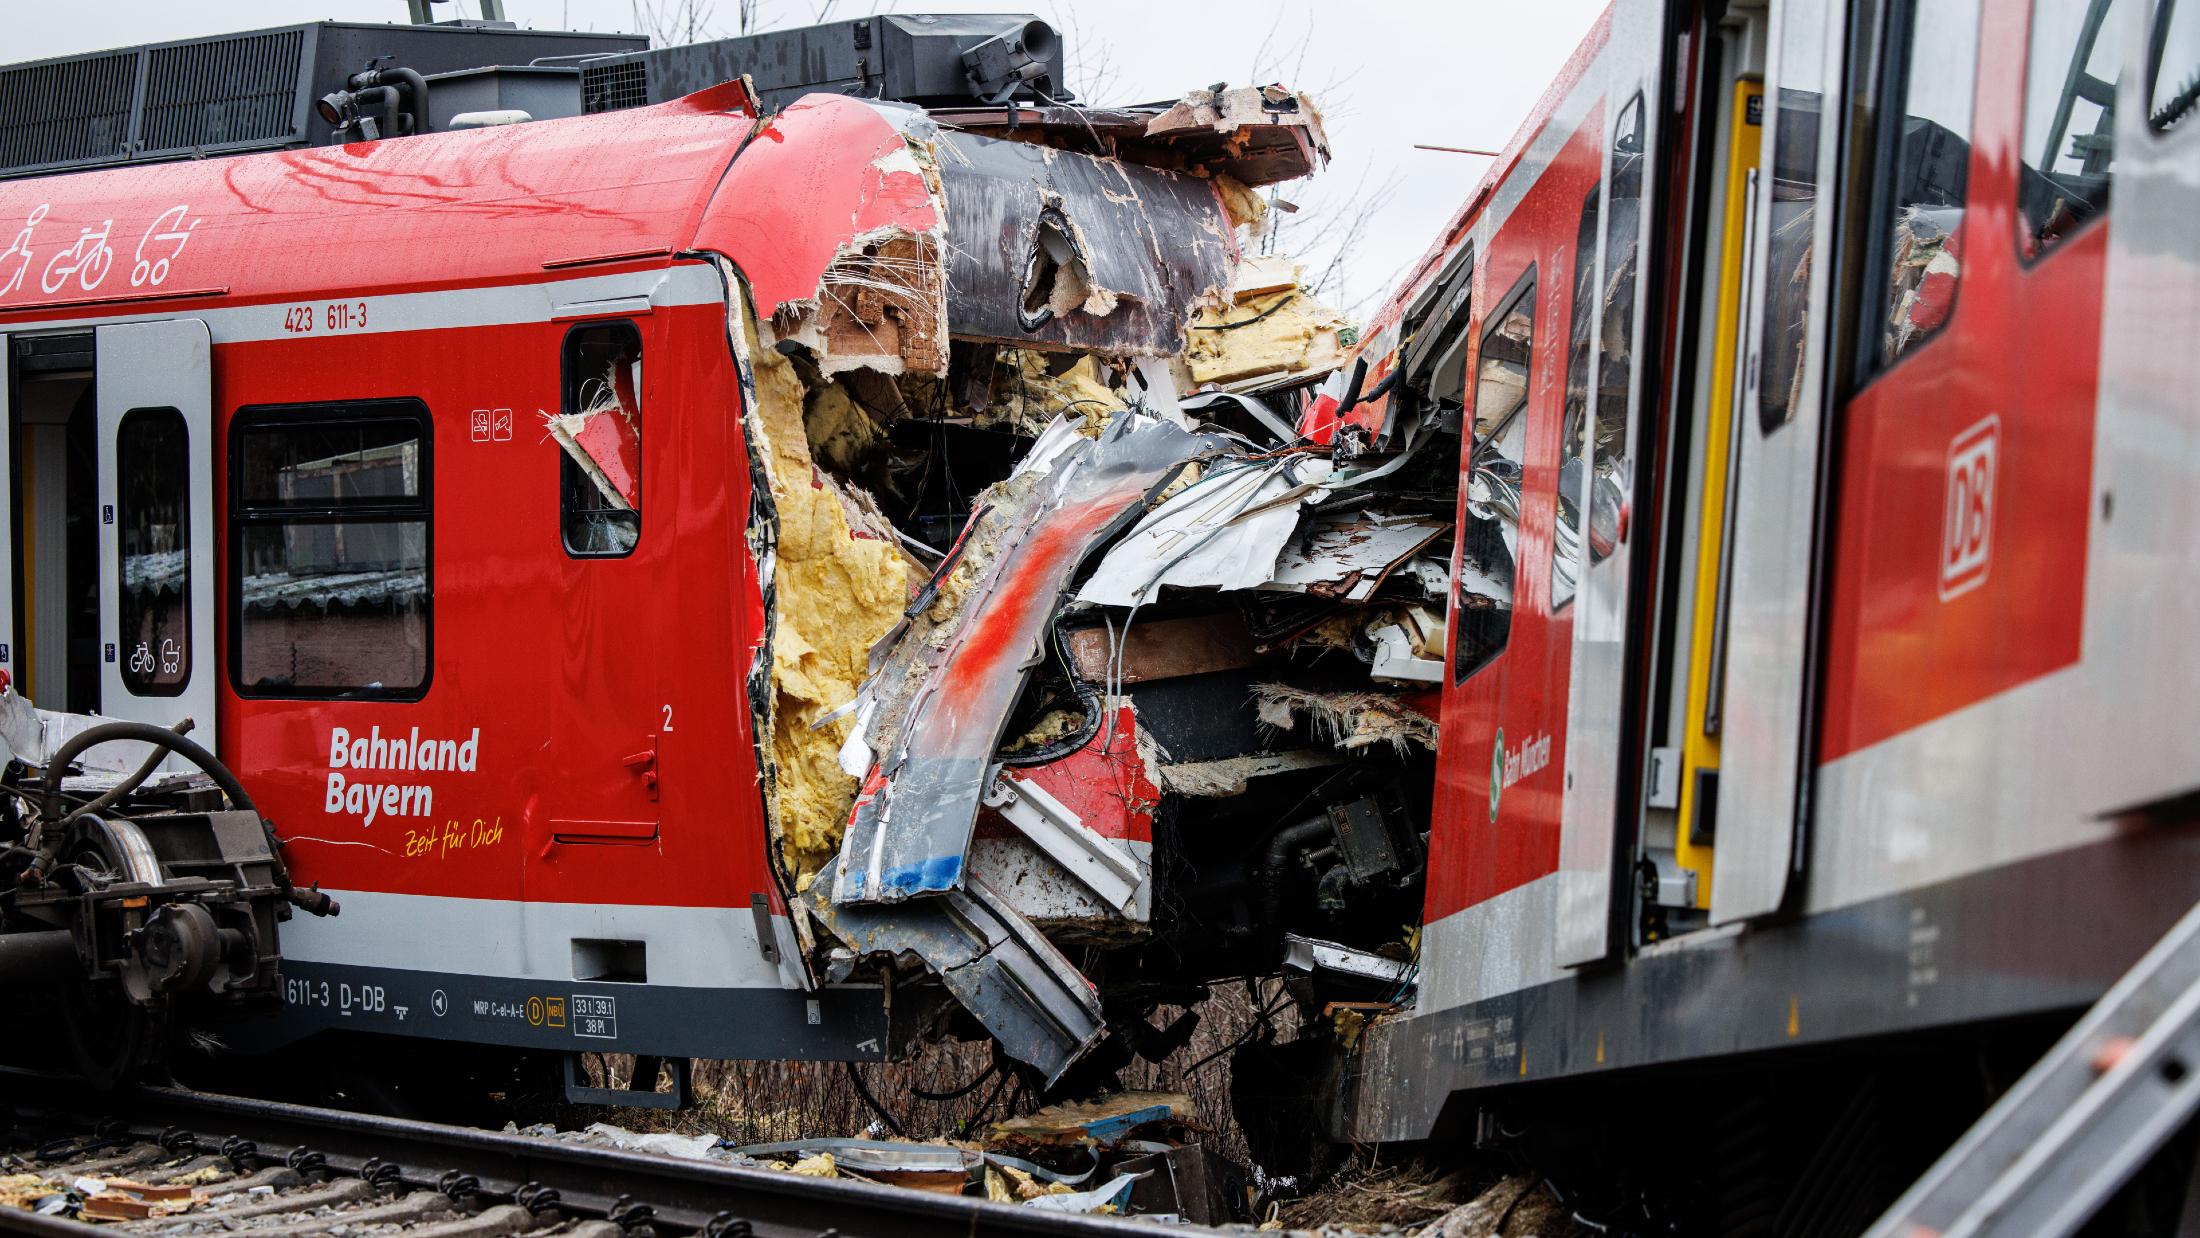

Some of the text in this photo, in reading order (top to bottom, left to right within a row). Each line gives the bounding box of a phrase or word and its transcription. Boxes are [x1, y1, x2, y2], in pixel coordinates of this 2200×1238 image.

[283, 302, 367, 332] 423 611-3
[1945, 438, 1993, 577] DB
[662, 703, 674, 732] 2
[329, 725, 480, 772] Bahnland
[325, 772, 433, 828] Bayern
[404, 816, 503, 860] Zeit für Dich
[287, 978, 385, 1013] 611-3 D-DB
[473, 1000, 489, 1015] MRP
[532, 1002, 541, 1020] D
